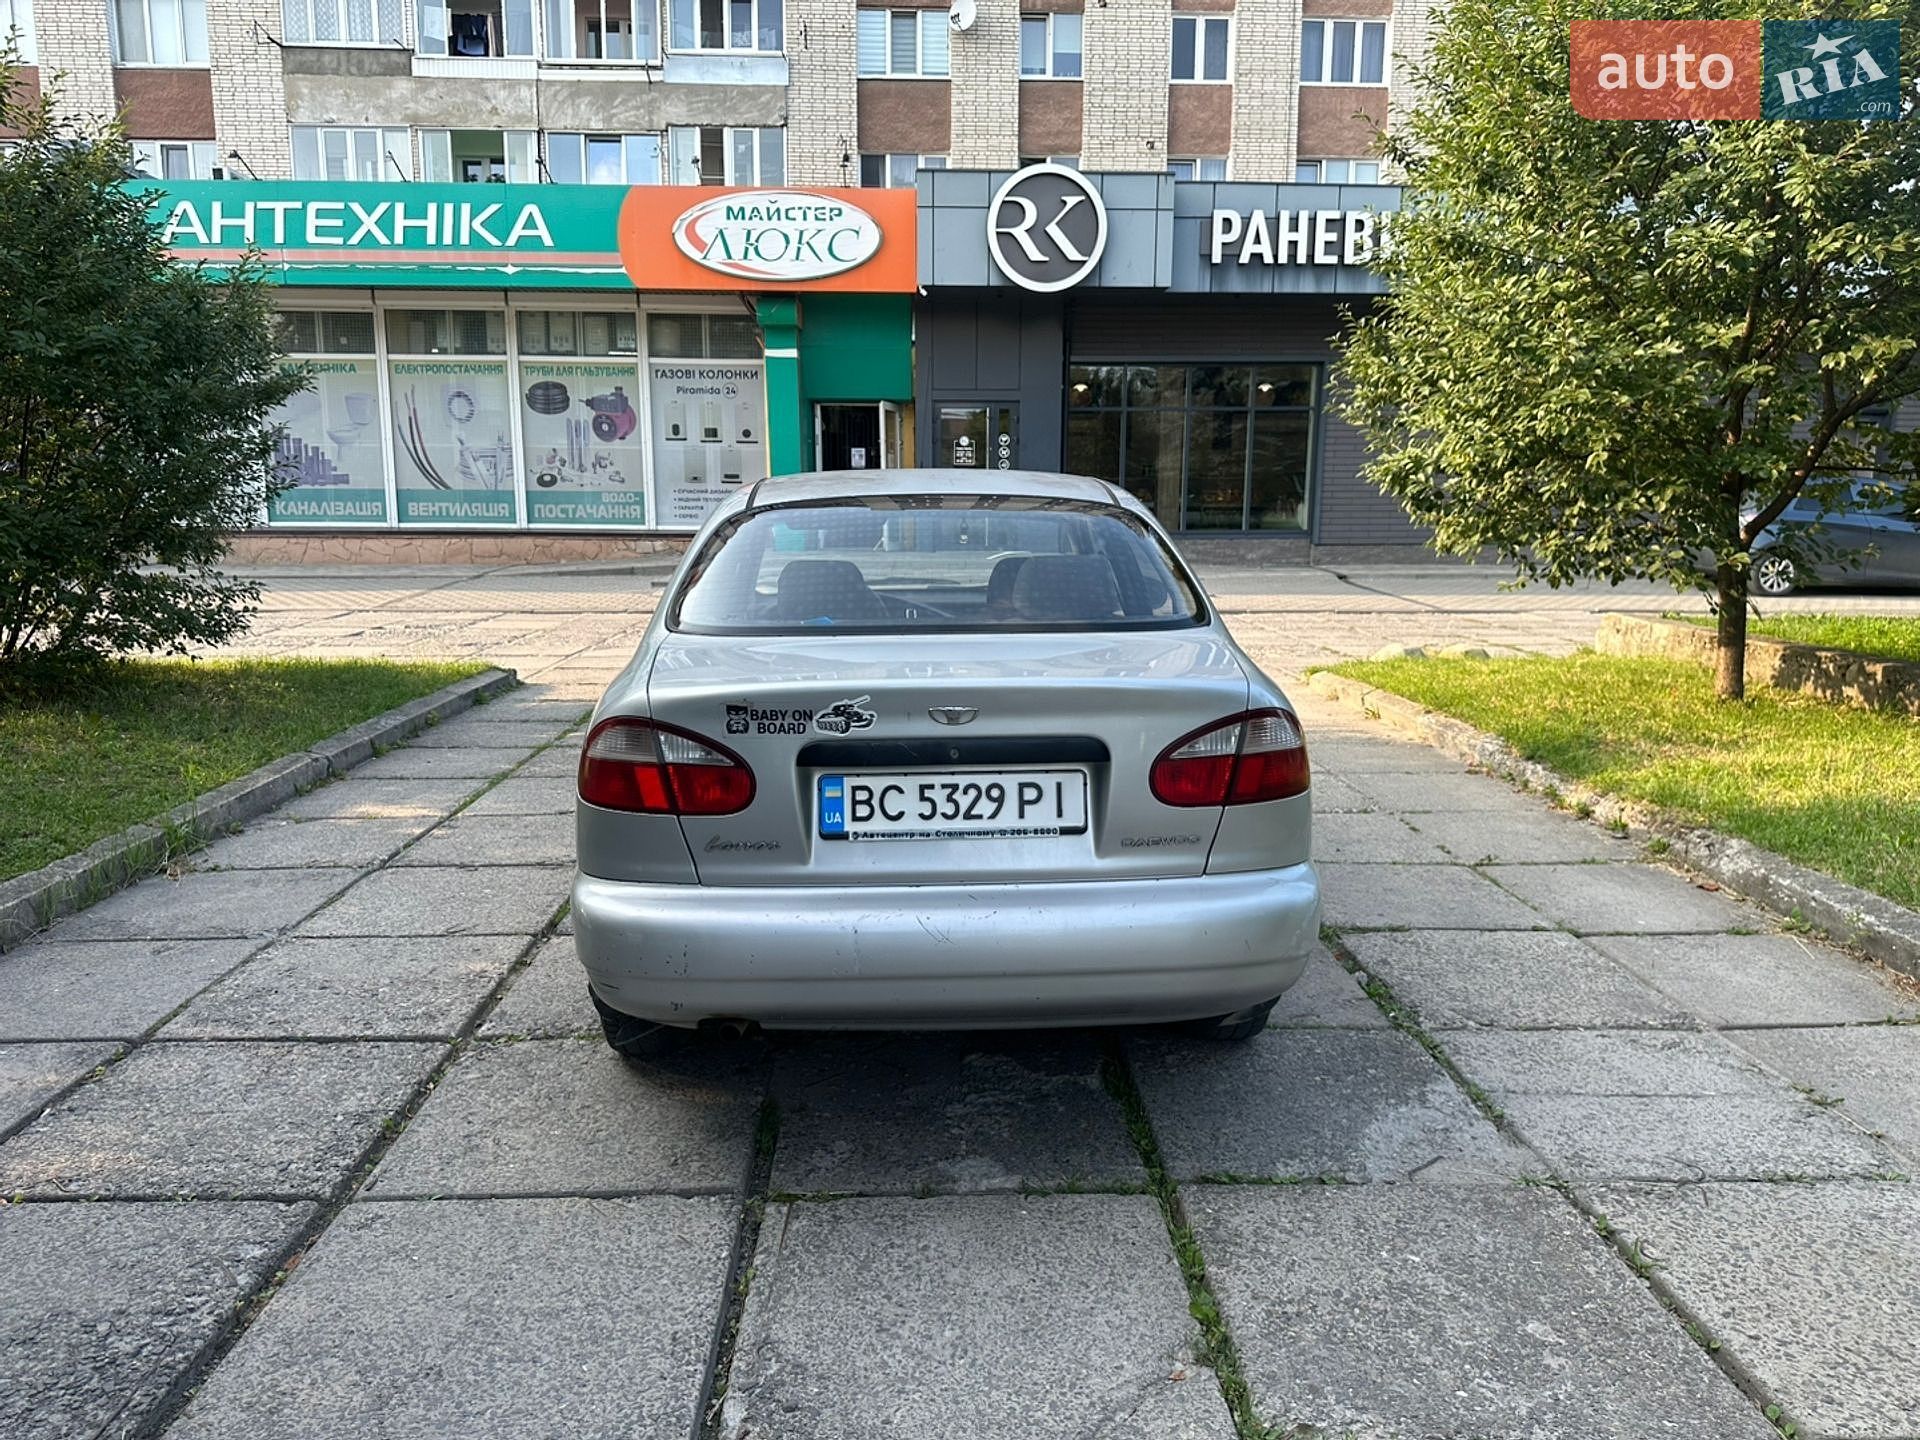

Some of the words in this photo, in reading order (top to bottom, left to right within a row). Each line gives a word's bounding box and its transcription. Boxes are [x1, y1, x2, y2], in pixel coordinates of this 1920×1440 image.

[725, 199, 843, 222] МАЙСТЕР
[144, 199, 554, 247] АНТЕХНІКА
[994, 195, 1090, 263] RK
[700, 226, 862, 263] ЛЮКС
[394, 364, 503, 375] ЕЛЕКТРОПОСТАЧАННЯ
[524, 366, 554, 376] ТРУБИ
[655, 369, 696, 380] ГАЗОВІ
[698, 369, 759, 380] КОЛОНКИ
[676, 385, 721, 396] Piramida
[724, 385, 737, 396] 24
[276, 502, 382, 516] КАНАЛІЗАЦІЯ
[408, 502, 509, 517] ВЕНТИЛЯЦІЯ
[534, 504, 641, 519] ПОСТАЧАННЯ
[750, 709, 788, 721] BABY
[792, 709, 813, 722] ON
[757, 722, 807, 735] BOARD
[850, 784, 906, 822] BC
[917, 782, 1006, 822] 5329
[825, 812, 842, 824] UA
